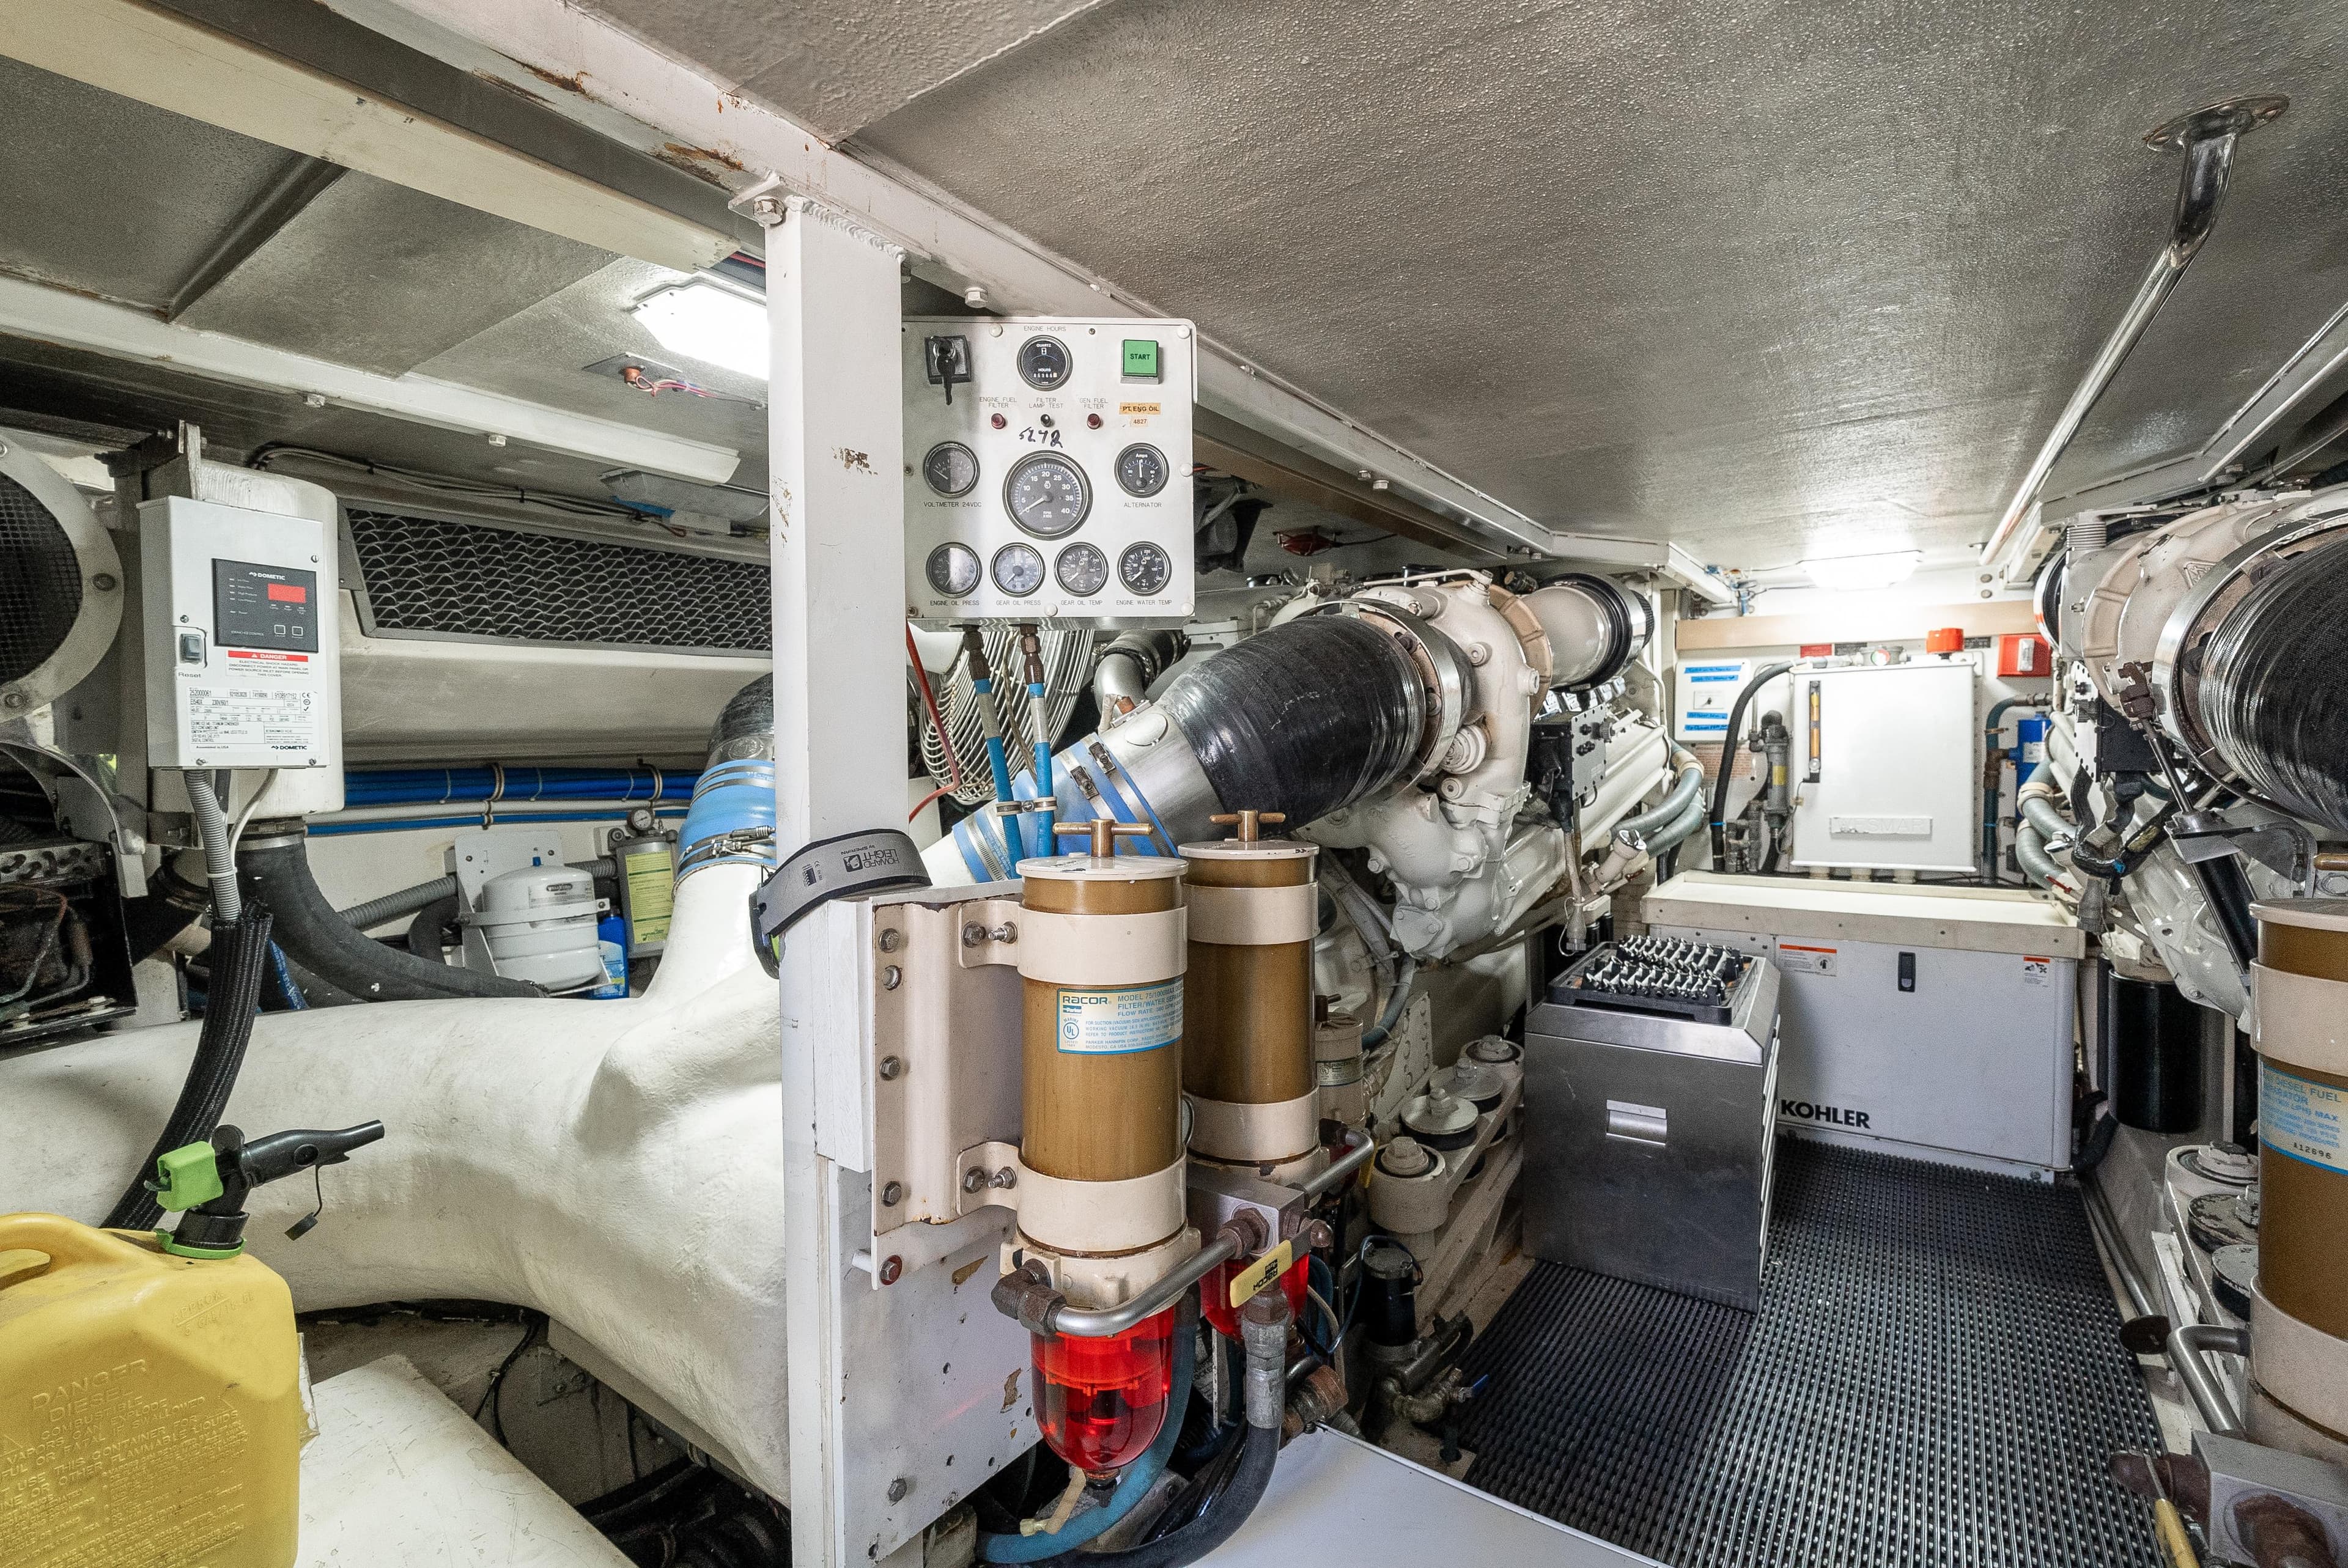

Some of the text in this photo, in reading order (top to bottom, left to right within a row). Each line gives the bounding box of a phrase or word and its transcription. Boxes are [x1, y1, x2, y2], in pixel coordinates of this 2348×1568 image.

[841, 845, 868, 855] SPERIAN
[862, 848, 899, 861] LEIGHT
[864, 858, 900, 868] HOWARD
[1118, 998, 1165, 1010] FILTER/WATER
[1067, 1026, 1075, 1036] UL
[2310, 1088, 2342, 1102] FUEL
[1781, 1100, 1871, 1129] KOHLER
[32, 1358, 145, 1408] DANGER
[41, 1397, 144, 1439] COMBUSTIBLE
[50, 1384, 131, 1421] DIESEL
[7, 1399, 167, 1463] VAPORS CAN EXPLODE
[36, 1452, 56, 1464] OR
[64, 1433, 105, 1452] FATAL
[132, 1397, 204, 1427] SWALLOWED
[18, 1415, 196, 1489] USE THIS CONTAINER FOR
[31, 1411, 238, 1496] OR OTHER FLAMMABLE LIQUIDS
